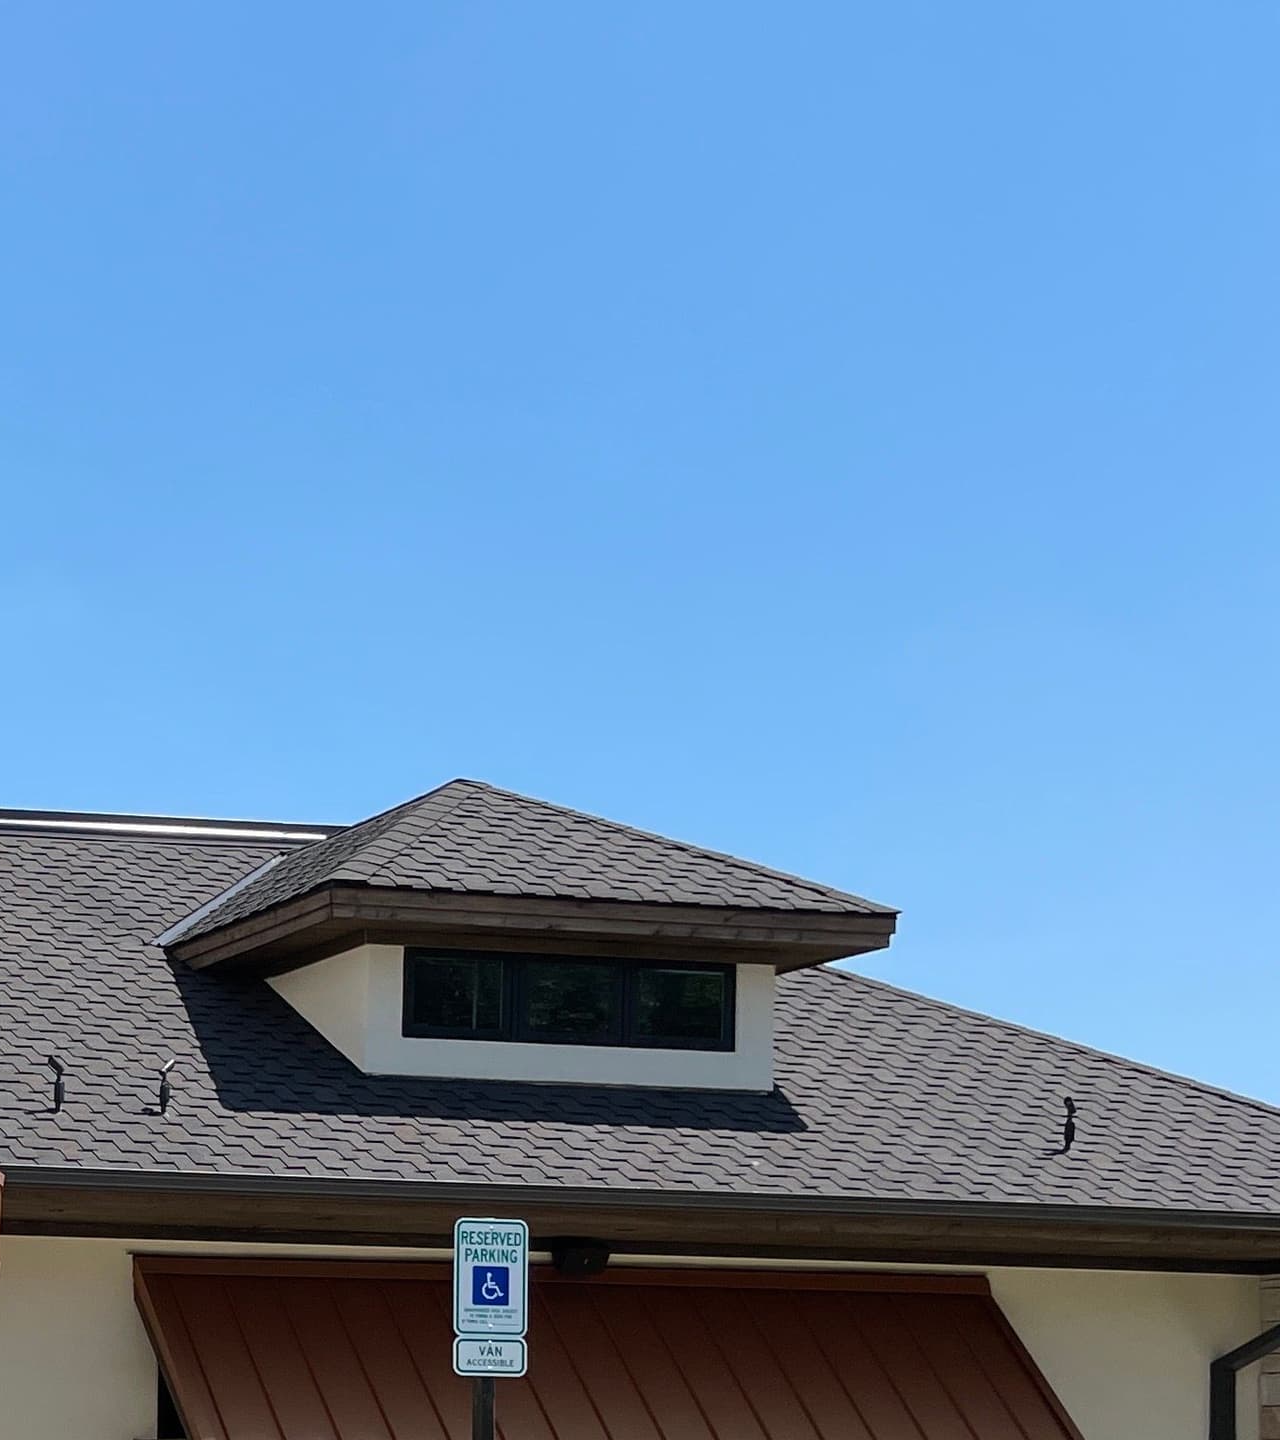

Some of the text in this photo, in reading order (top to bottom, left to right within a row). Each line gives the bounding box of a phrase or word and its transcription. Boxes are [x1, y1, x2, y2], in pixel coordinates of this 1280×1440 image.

[461, 1231, 521, 1246] RESERVED
[464, 1249, 518, 1263] PARKING
[479, 1346, 503, 1357] VAN
[466, 1358, 515, 1368] ACCESSIBLE
